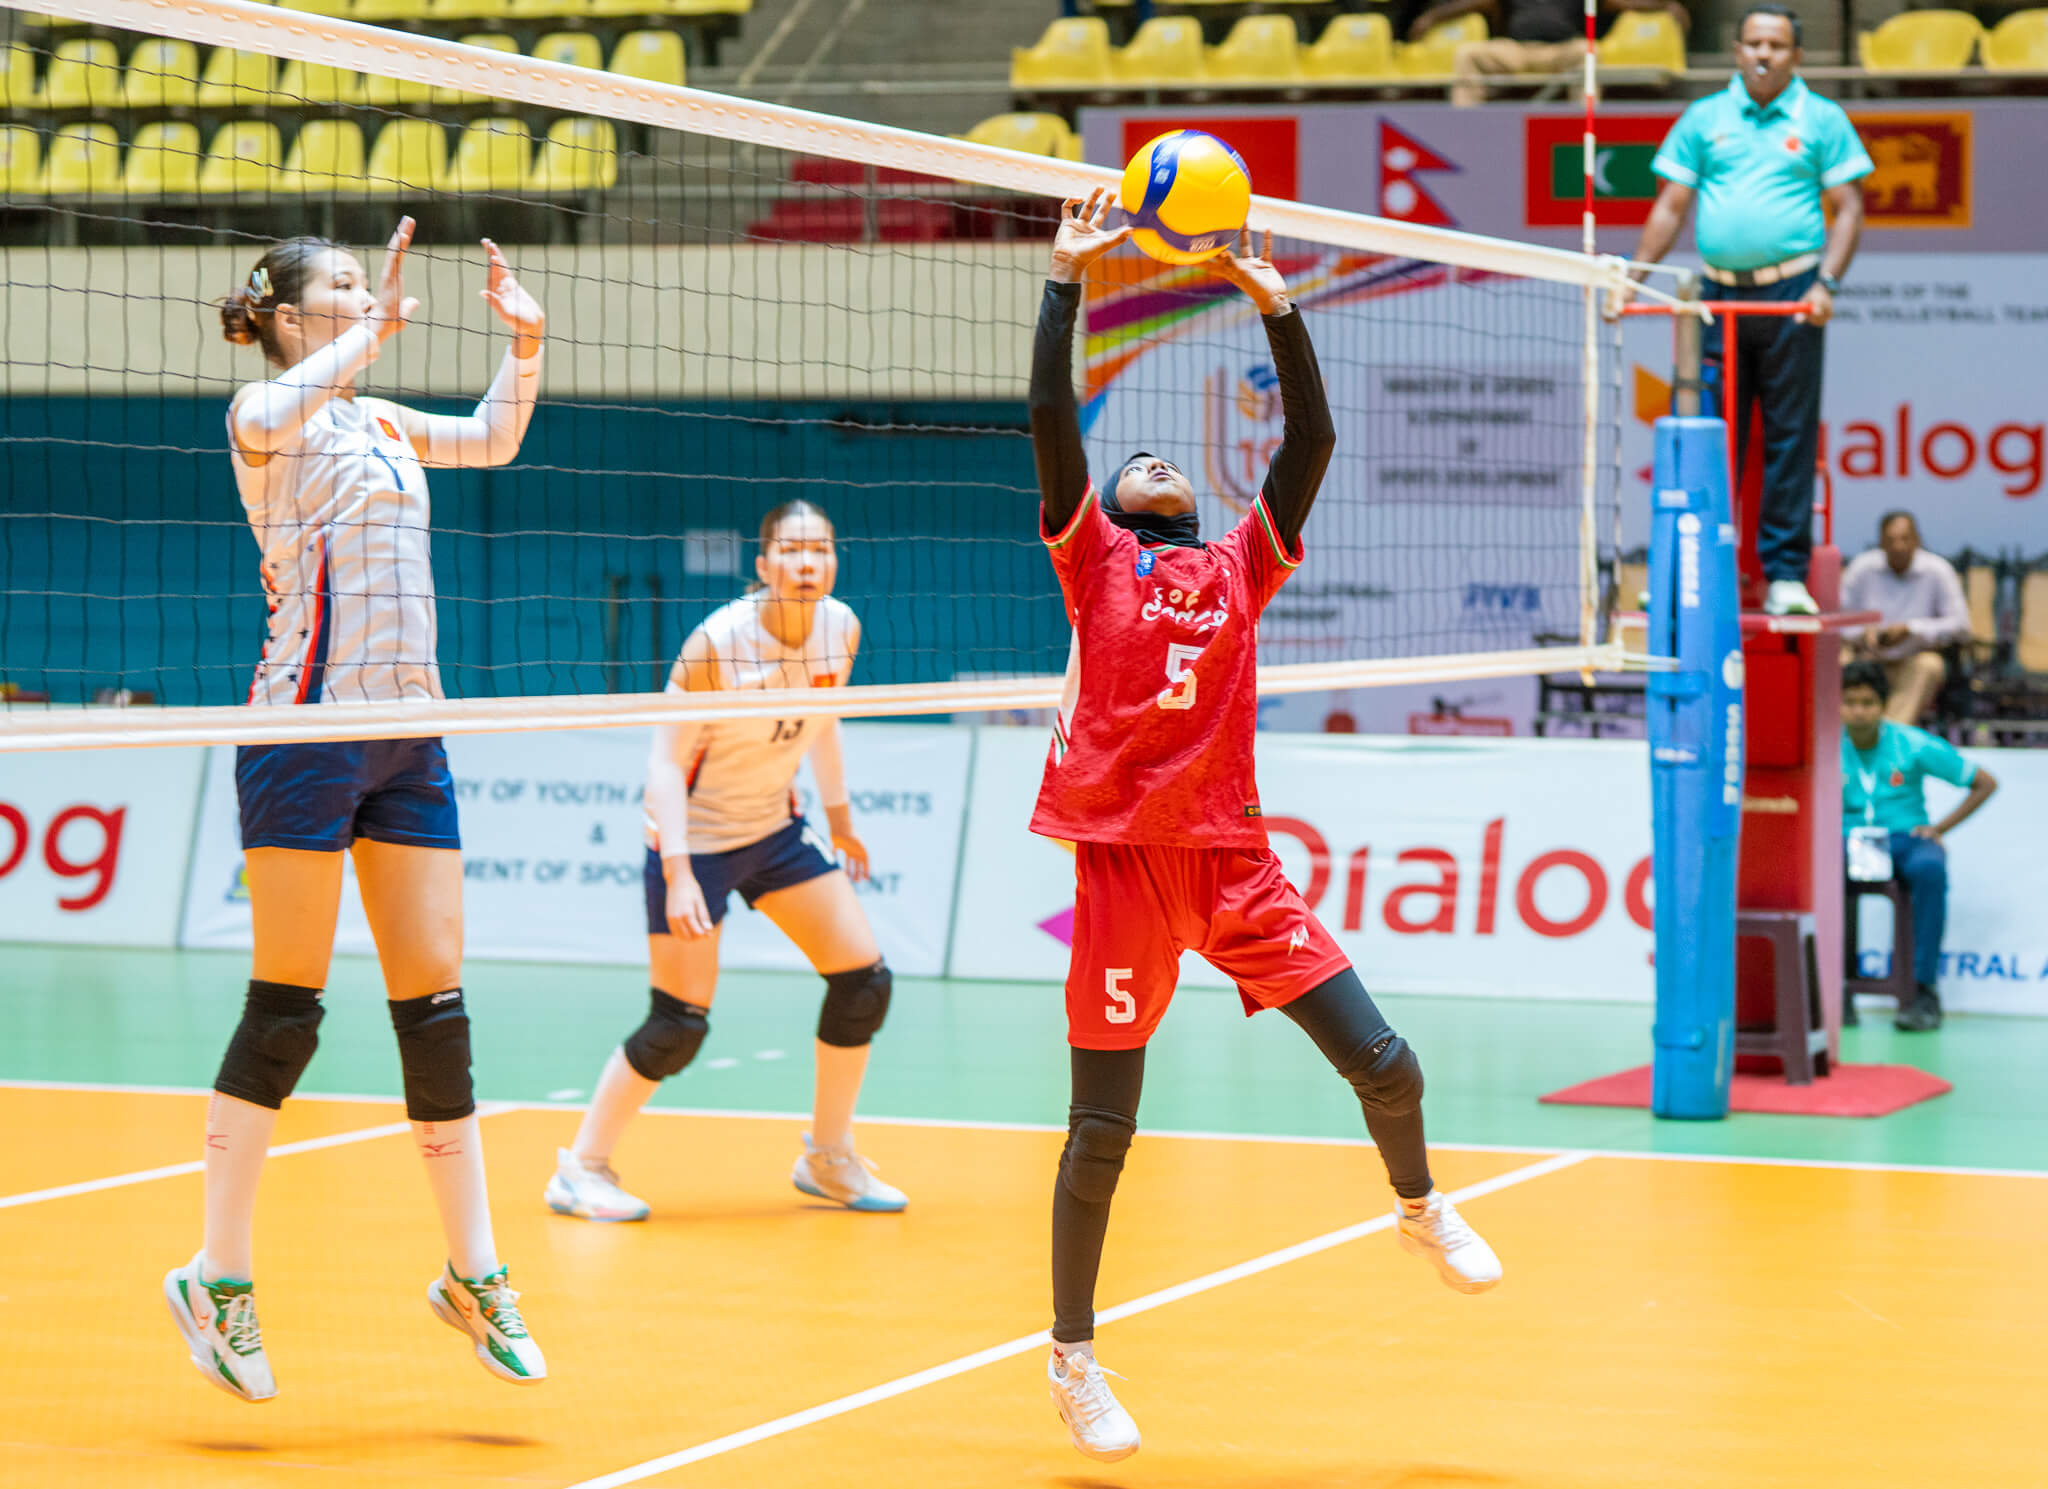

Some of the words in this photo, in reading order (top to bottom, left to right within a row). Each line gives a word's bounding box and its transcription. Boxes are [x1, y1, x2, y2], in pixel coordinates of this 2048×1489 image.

[1157, 642, 1206, 710] 5
[491, 779, 525, 804] OF
[537, 780, 628, 806] YOUTH
[850, 789, 931, 816] PORTS
[536, 862, 568, 884] OF
[1105, 968, 1137, 1024] 5
